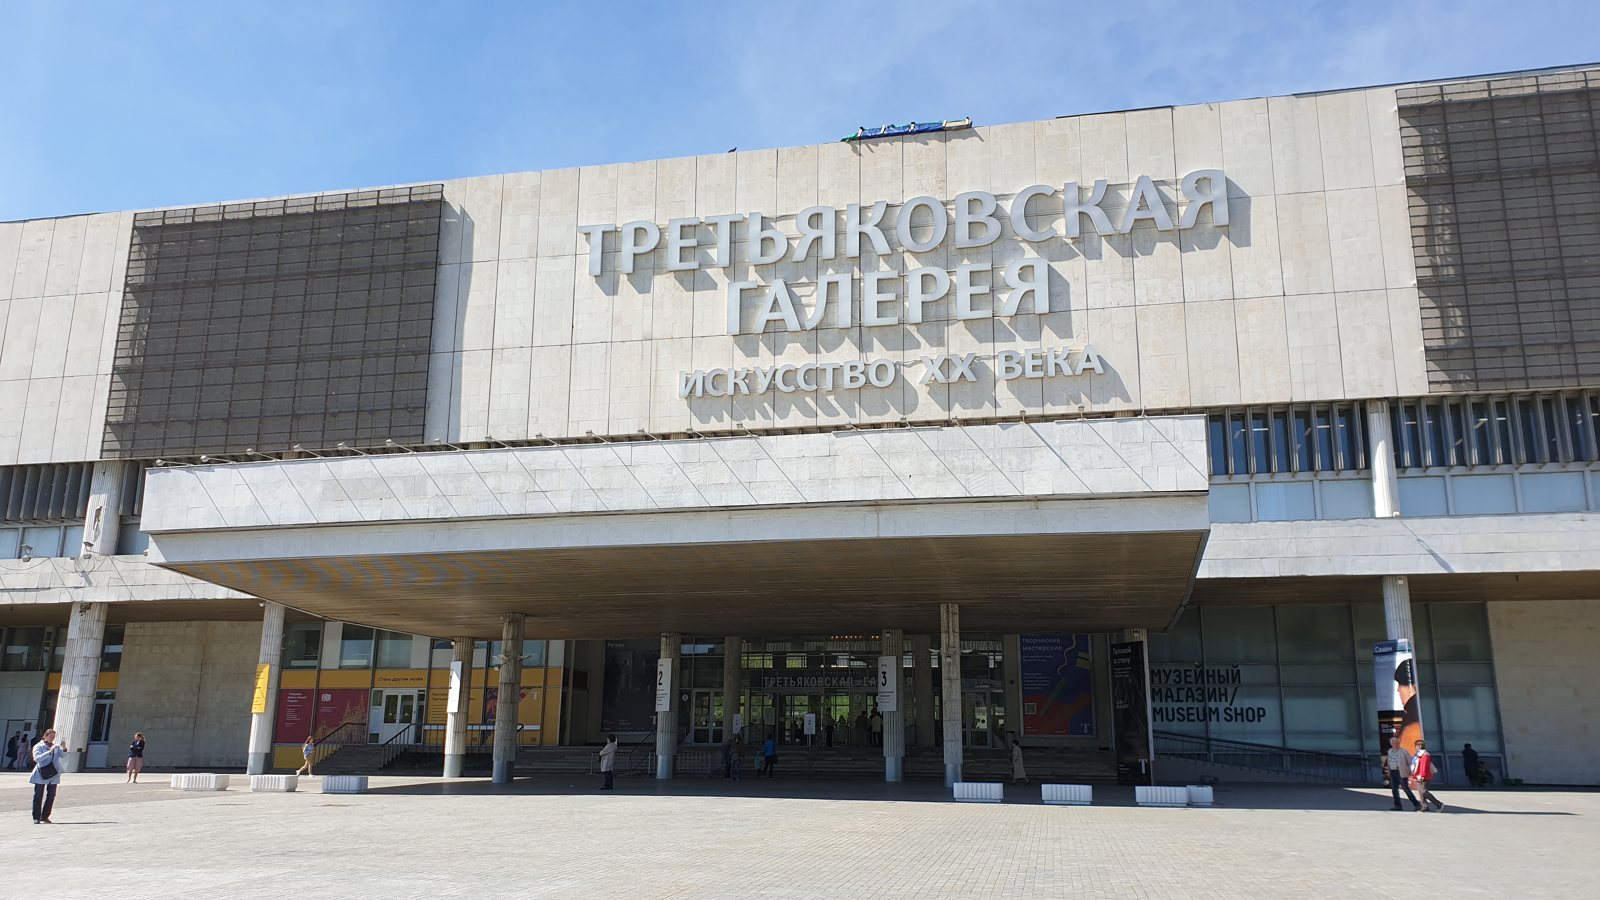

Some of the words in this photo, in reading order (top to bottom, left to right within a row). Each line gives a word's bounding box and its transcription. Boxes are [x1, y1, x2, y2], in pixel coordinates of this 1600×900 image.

[578, 169, 1230, 277] ТРЕТЬЯКОВСКАЯ
[726, 257, 1051, 336] ГАЛЕРЕЯ
[678, 357, 897, 399] ИСКУССТВО
[1000, 344, 1104, 381] ВЕКА
[658, 670, 663, 685] 2
[881, 671, 887, 687] 3
[1151, 664, 1241, 684] МУЗЕЙНЫЙ
[1152, 706, 1220, 722] MUSEUM
[1223, 706, 1266, 722] SHOP
